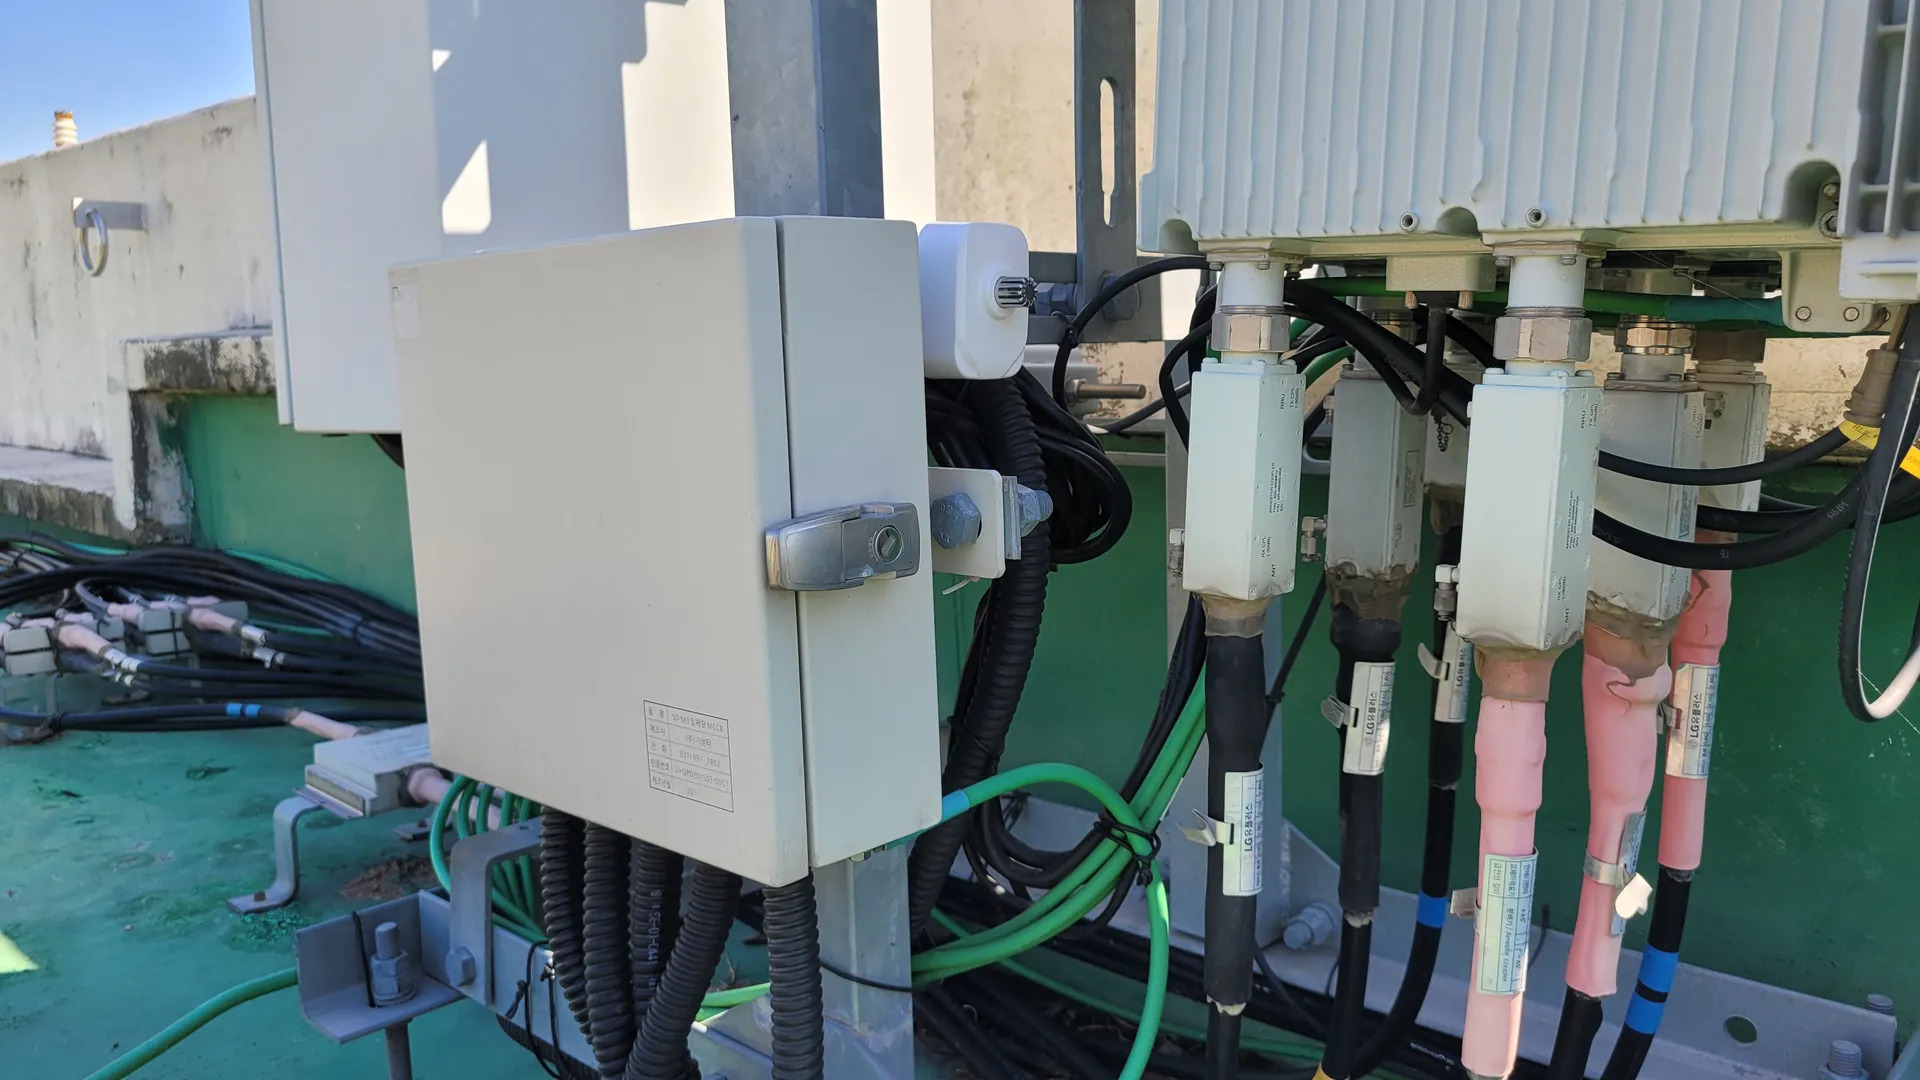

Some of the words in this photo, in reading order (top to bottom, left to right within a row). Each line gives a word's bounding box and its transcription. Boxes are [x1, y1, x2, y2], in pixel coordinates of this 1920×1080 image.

[1365, 691, 1377, 736] LG유플러스
[1689, 692, 1702, 739] LG유플러스
[1244, 802, 1254, 852] LG유플러스
